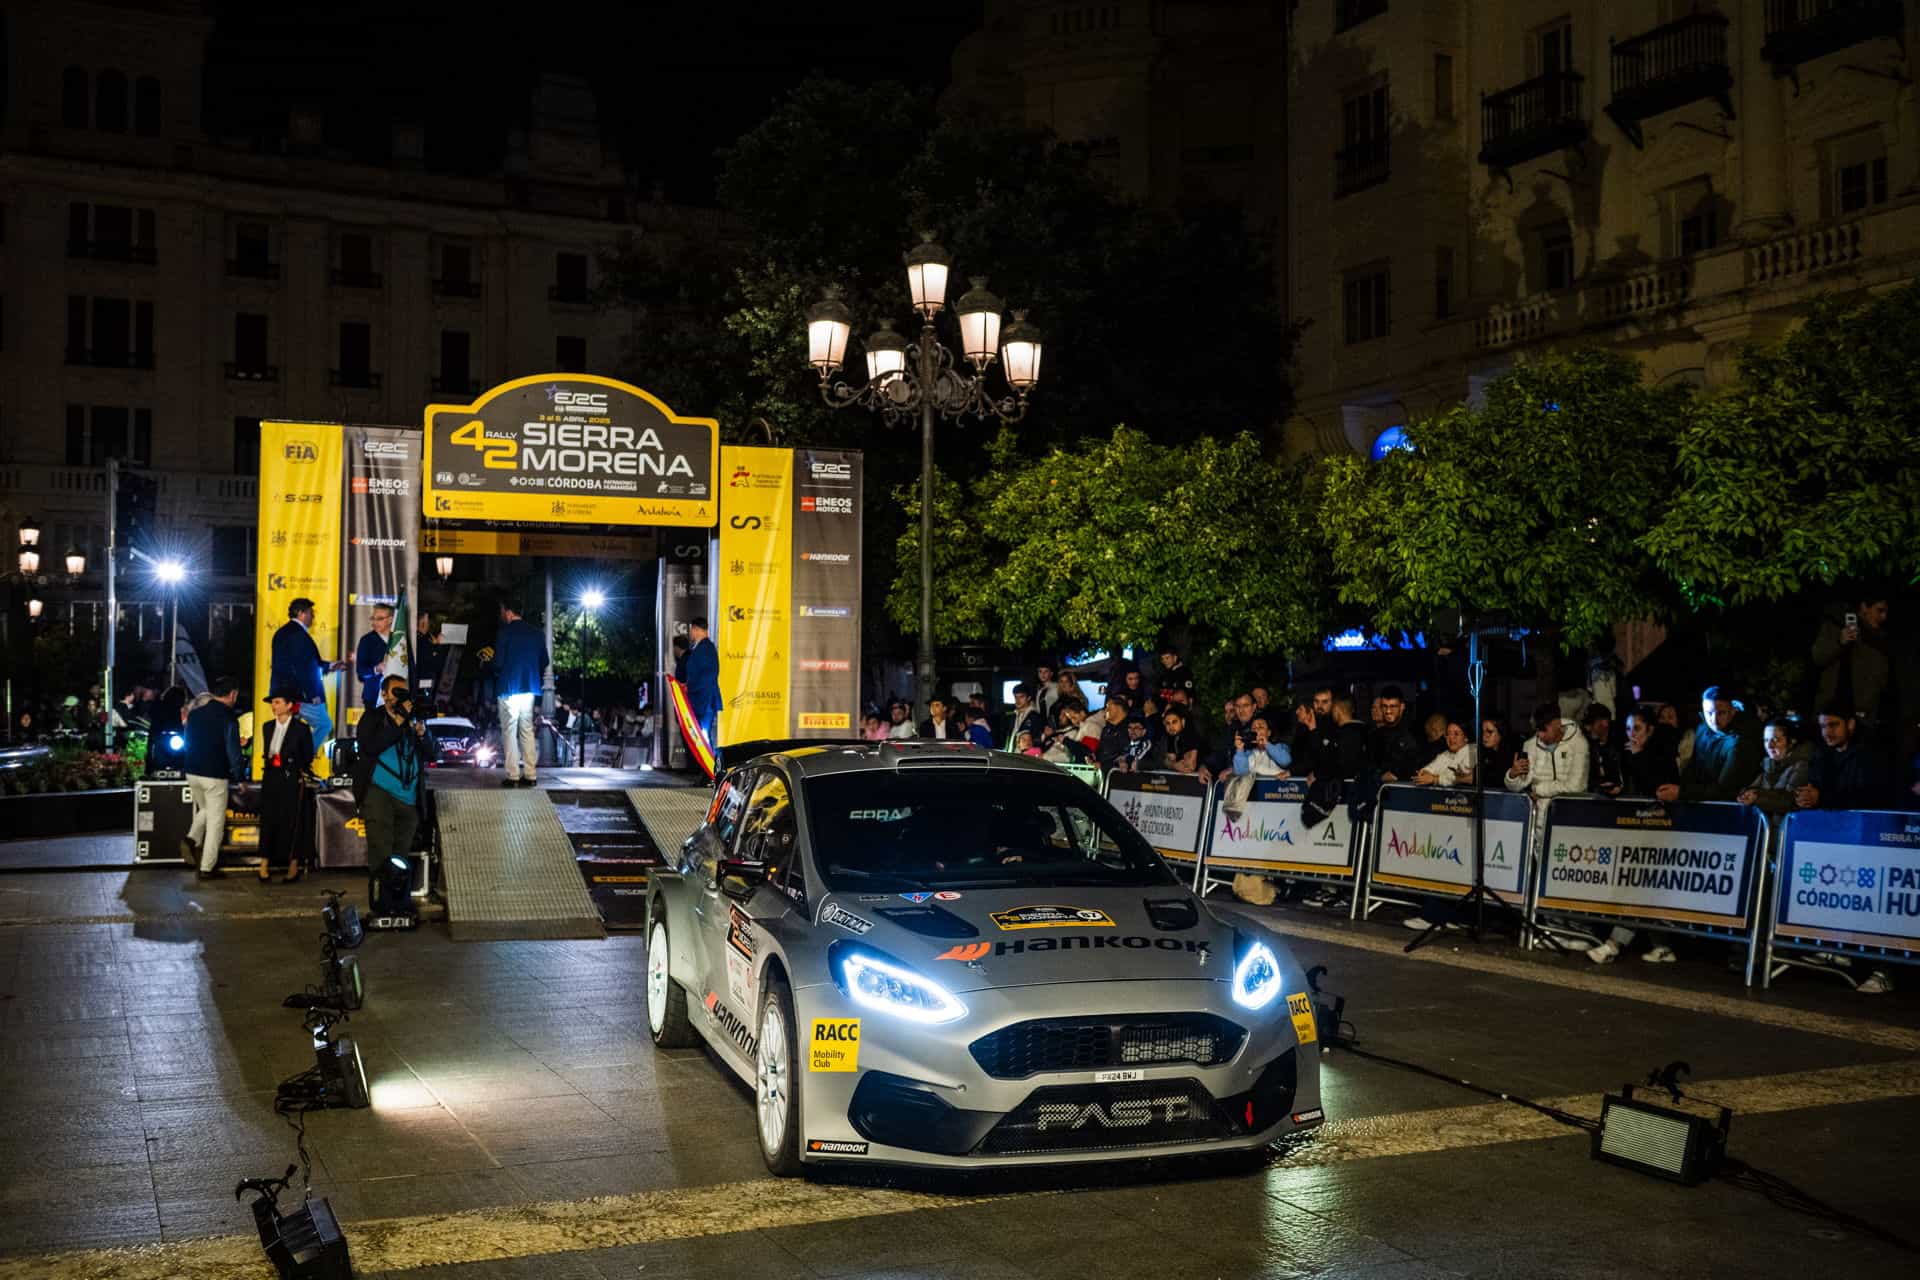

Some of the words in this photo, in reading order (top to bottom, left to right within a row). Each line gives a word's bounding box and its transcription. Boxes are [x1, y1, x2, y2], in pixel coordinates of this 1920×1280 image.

[486, 431, 517, 440] RALLY
[523, 422, 663, 453] SIERRA
[285, 446, 315, 459] FIA
[364, 442, 409, 453] ERC
[523, 454, 694, 478] MORENA
[811, 463, 851, 474] ERC
[369, 478, 409, 488] ENEOS
[548, 477, 602, 490] CÓRDOBA
[816, 496, 852, 507] ENEOS
[1221, 817, 1294, 846] Andalucía
[1388, 827, 1463, 865] Andalucía
[1621, 847, 1721, 871] PATRIMONIO
[1725, 853, 1737, 861] DE
[1723, 863, 1735, 871] LA
[1551, 867, 1609, 885] CÓRDOBA
[1616, 868, 1735, 896] HUMANIDAD
[1796, 887, 1873, 913] CÓRDOBA
[1290, 998, 1310, 1016] RACC
[816, 1022, 858, 1042] RACC
[814, 1050, 845, 1061] Mobility
[814, 1060, 831, 1069] Club
